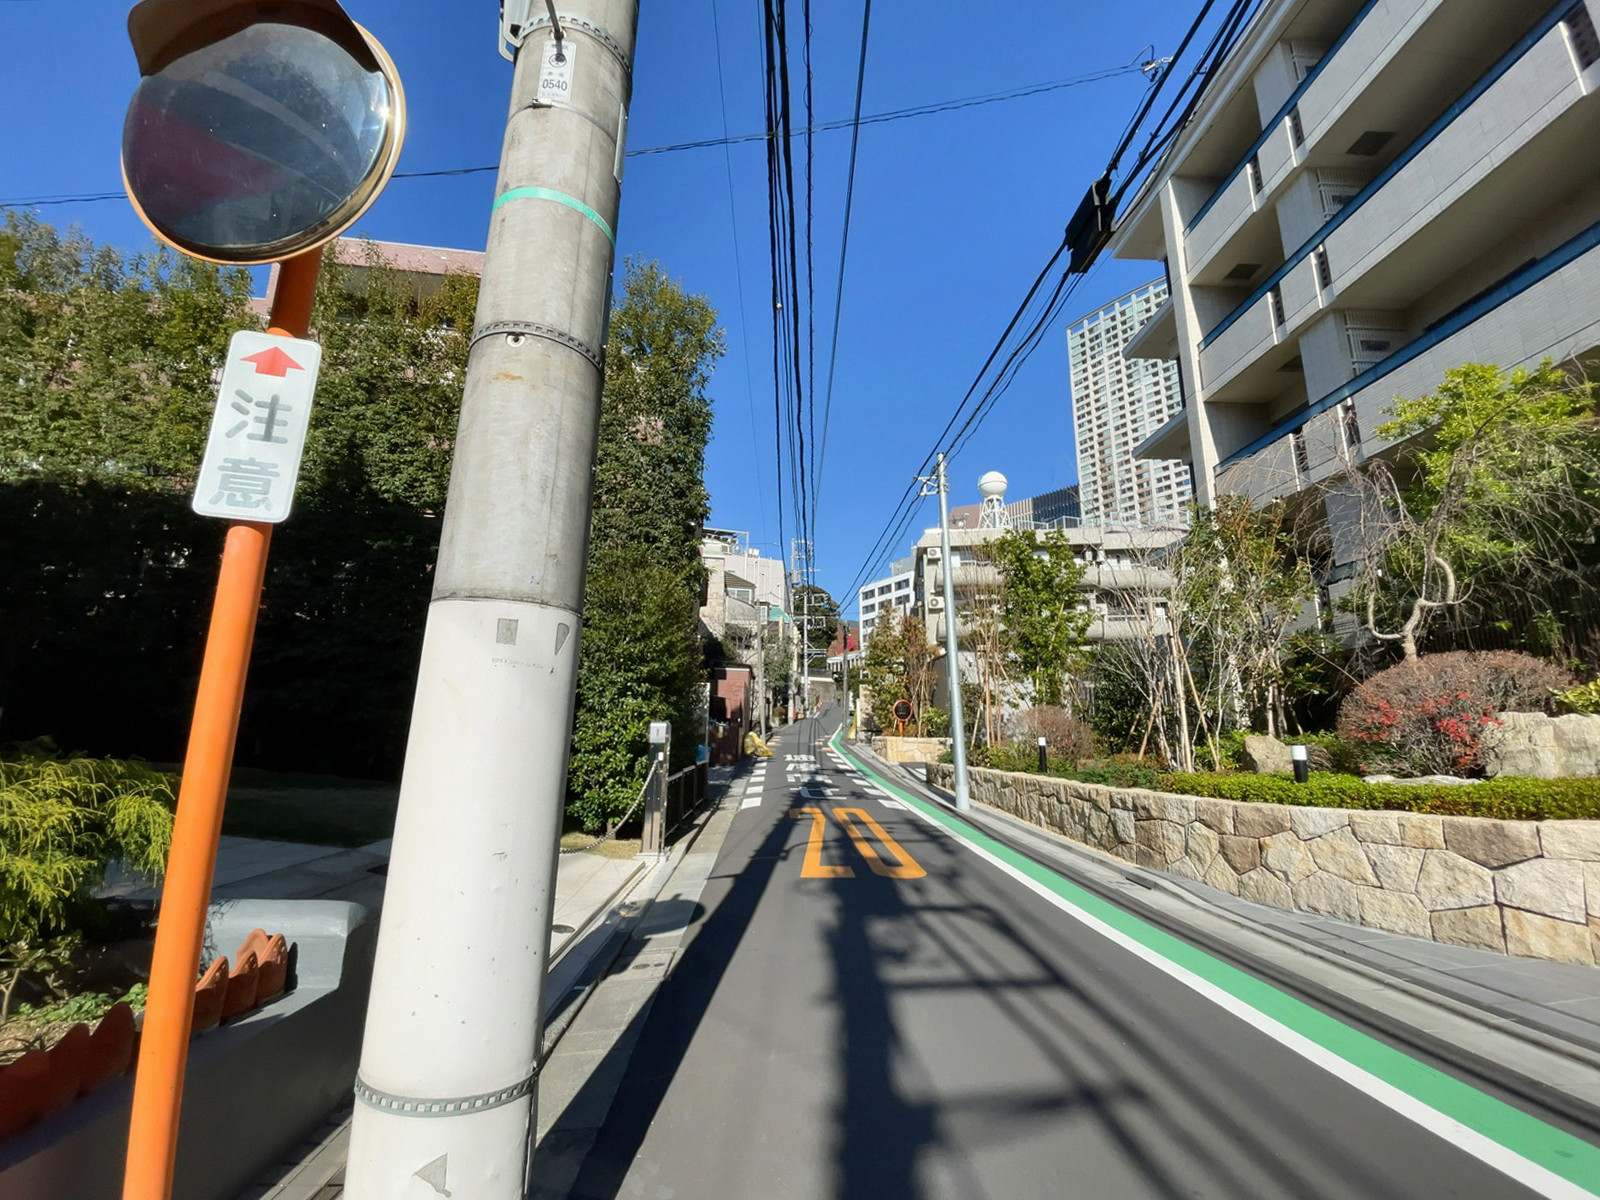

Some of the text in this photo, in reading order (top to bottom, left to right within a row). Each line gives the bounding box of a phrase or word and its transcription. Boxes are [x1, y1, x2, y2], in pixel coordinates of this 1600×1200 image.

[542, 79, 568, 91] 0540
[208, 388, 293, 511] 注意
[789, 807, 928, 880] 20
